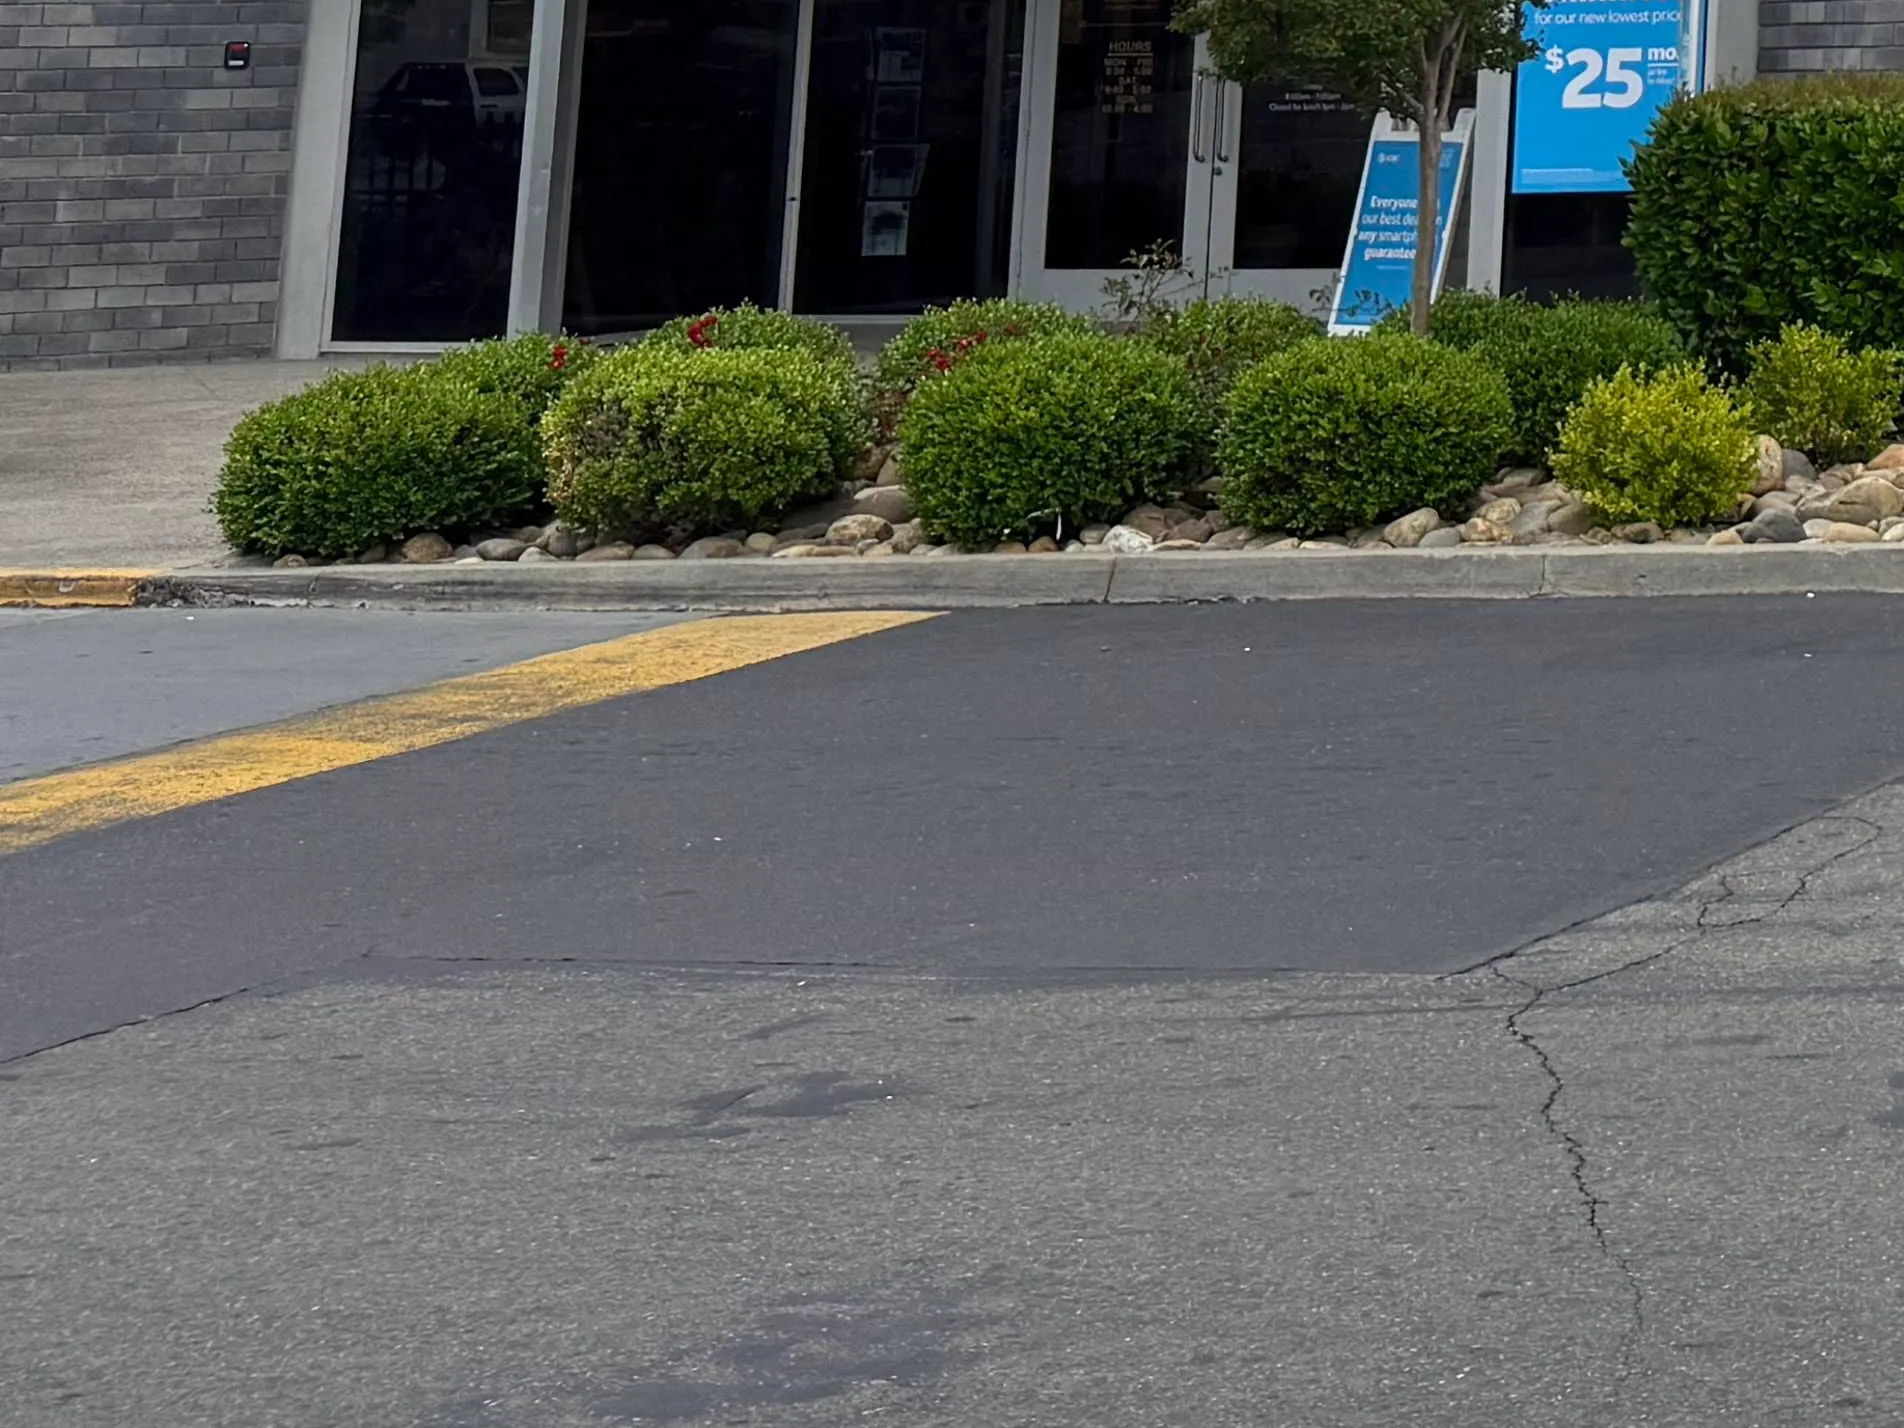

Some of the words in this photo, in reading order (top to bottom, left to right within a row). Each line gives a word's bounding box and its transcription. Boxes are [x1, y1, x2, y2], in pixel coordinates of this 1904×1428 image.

[1535, 11, 1552, 25] for
[1554, 11, 1576, 25] our
[1579, 12, 1606, 24] new
[1608, 8, 1648, 23] lowest
[1109, 40, 1153, 52] HOURS
[1361, 214, 1378, 225] our
[1379, 211, 1401, 225] best
